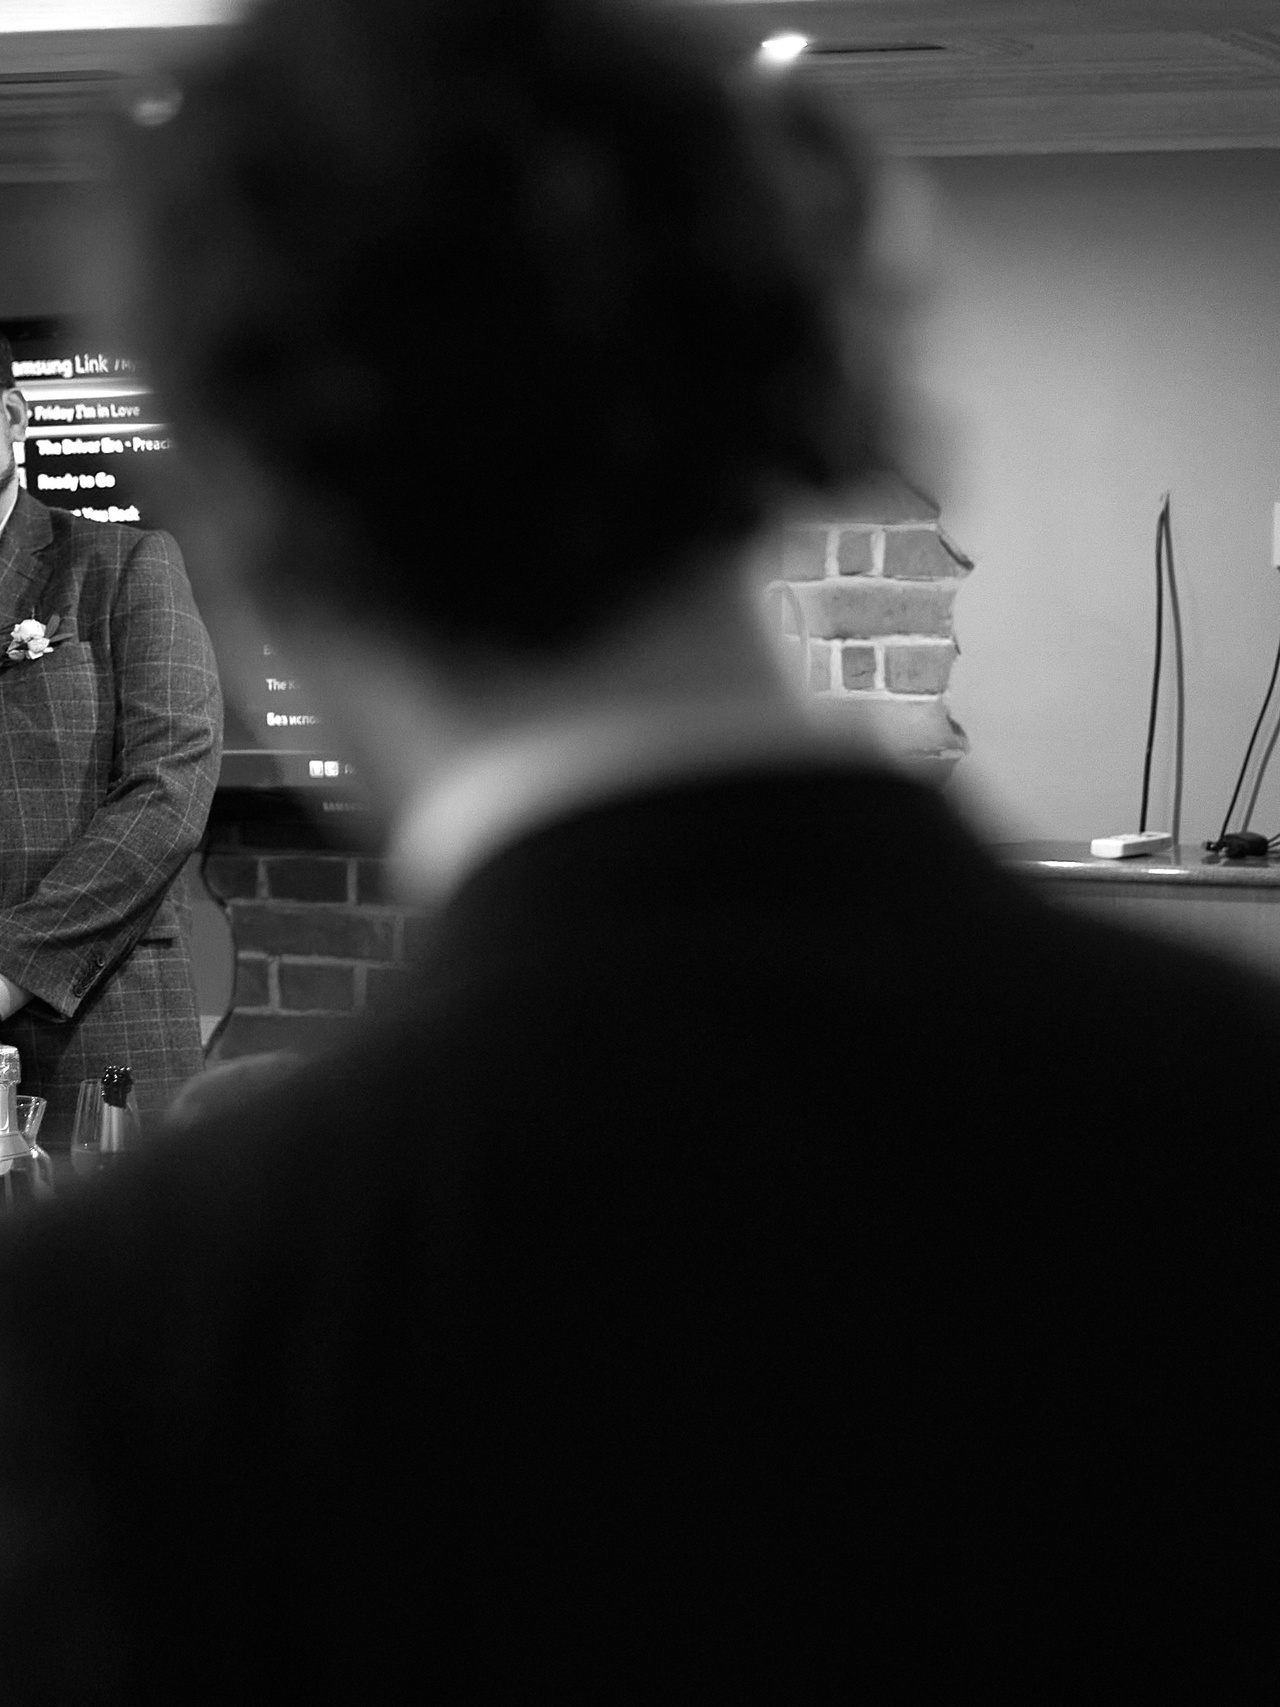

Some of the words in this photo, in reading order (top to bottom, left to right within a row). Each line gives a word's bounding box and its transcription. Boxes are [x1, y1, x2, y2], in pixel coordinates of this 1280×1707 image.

[11, 359, 73, 378] amsung
[74, 353, 109, 374] Link
[34, 405, 74, 422] Friday
[110, 403, 140, 418] Love
[37, 473, 78, 491] Ready
[79, 474, 95, 489] to
[95, 471, 115, 488] Go
[266, 678, 287, 691] The
[267, 712, 288, 726] Без
